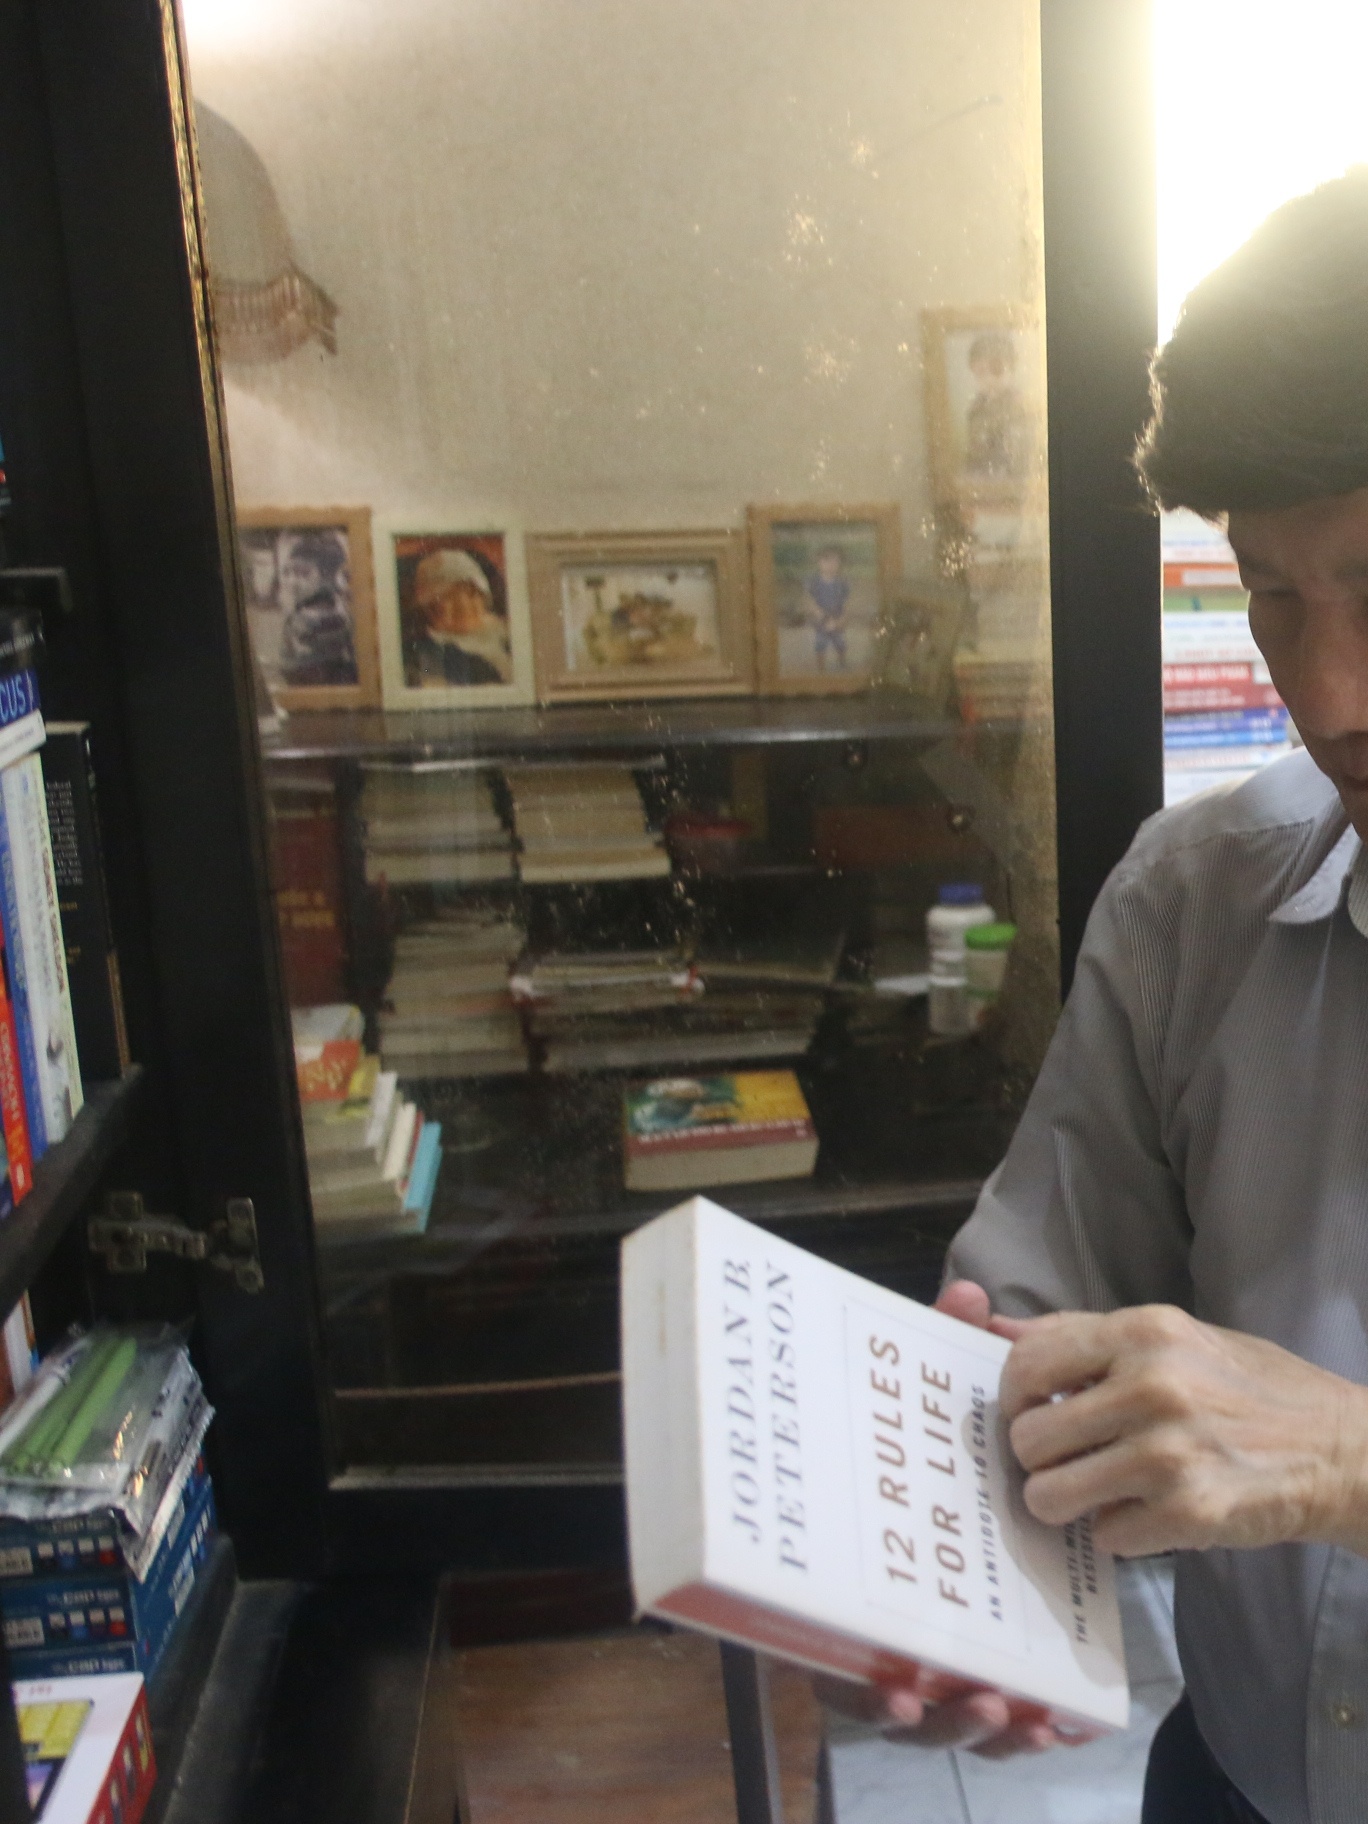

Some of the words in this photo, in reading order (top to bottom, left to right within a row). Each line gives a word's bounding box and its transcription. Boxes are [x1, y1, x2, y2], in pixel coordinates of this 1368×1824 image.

[724, 1304, 762, 1545] JORDAN
[766, 1258, 808, 1572] PETERSON
[868, 1334, 911, 1509] RULES
[920, 1360, 957, 1479] LIFE
[971, 1384, 986, 1449] CHAOS
[974, 1455, 988, 1479] TO
[882, 1527, 919, 1585] 12
[931, 1503, 970, 1609] FOR
[977, 1487, 999, 1587] ANTIDOTE
[990, 1596, 1003, 1622] AN
[1075, 1613, 1089, 1644] THE
